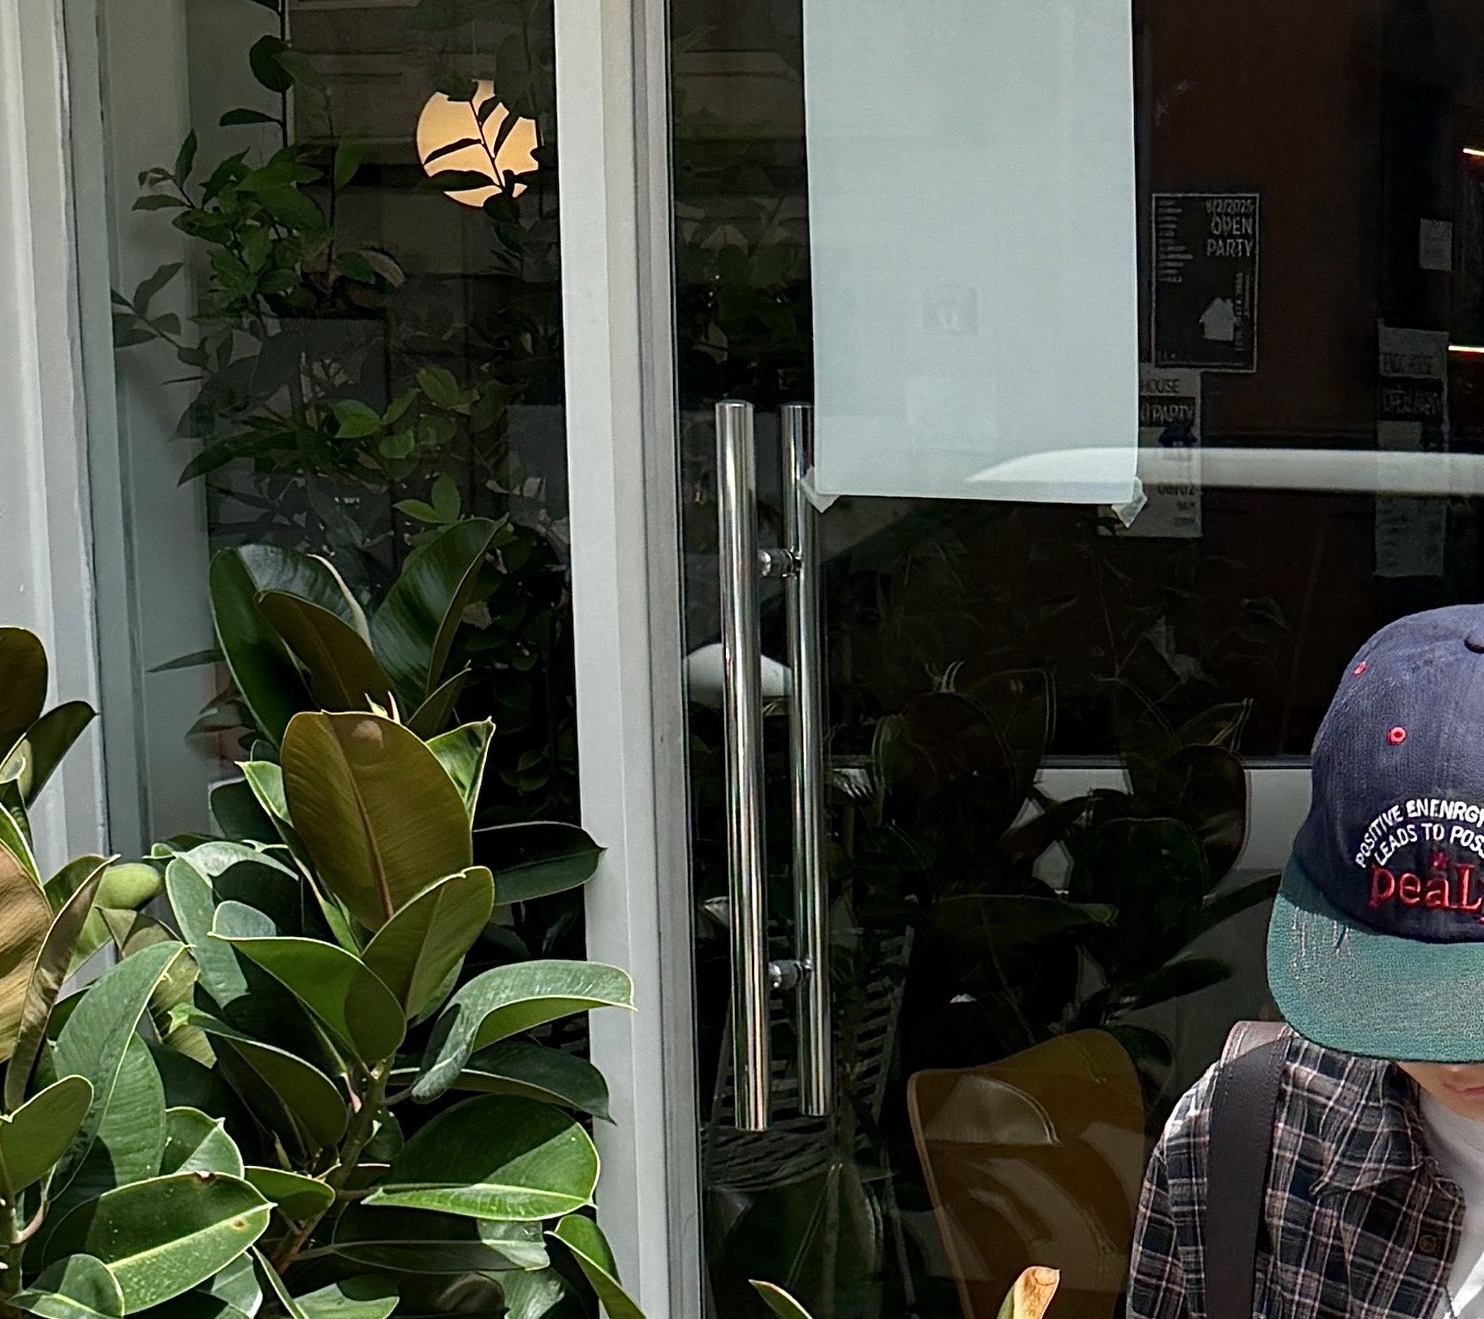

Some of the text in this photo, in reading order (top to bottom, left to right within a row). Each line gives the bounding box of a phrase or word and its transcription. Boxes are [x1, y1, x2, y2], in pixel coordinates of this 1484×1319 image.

[1210, 214, 1254, 236] OPEN
[1206, 238, 1254, 258] PARTY
[1355, 804, 1404, 869] POSITIVE
[1374, 824, 1418, 866] LEADS
[1420, 822, 1445, 841] TO
